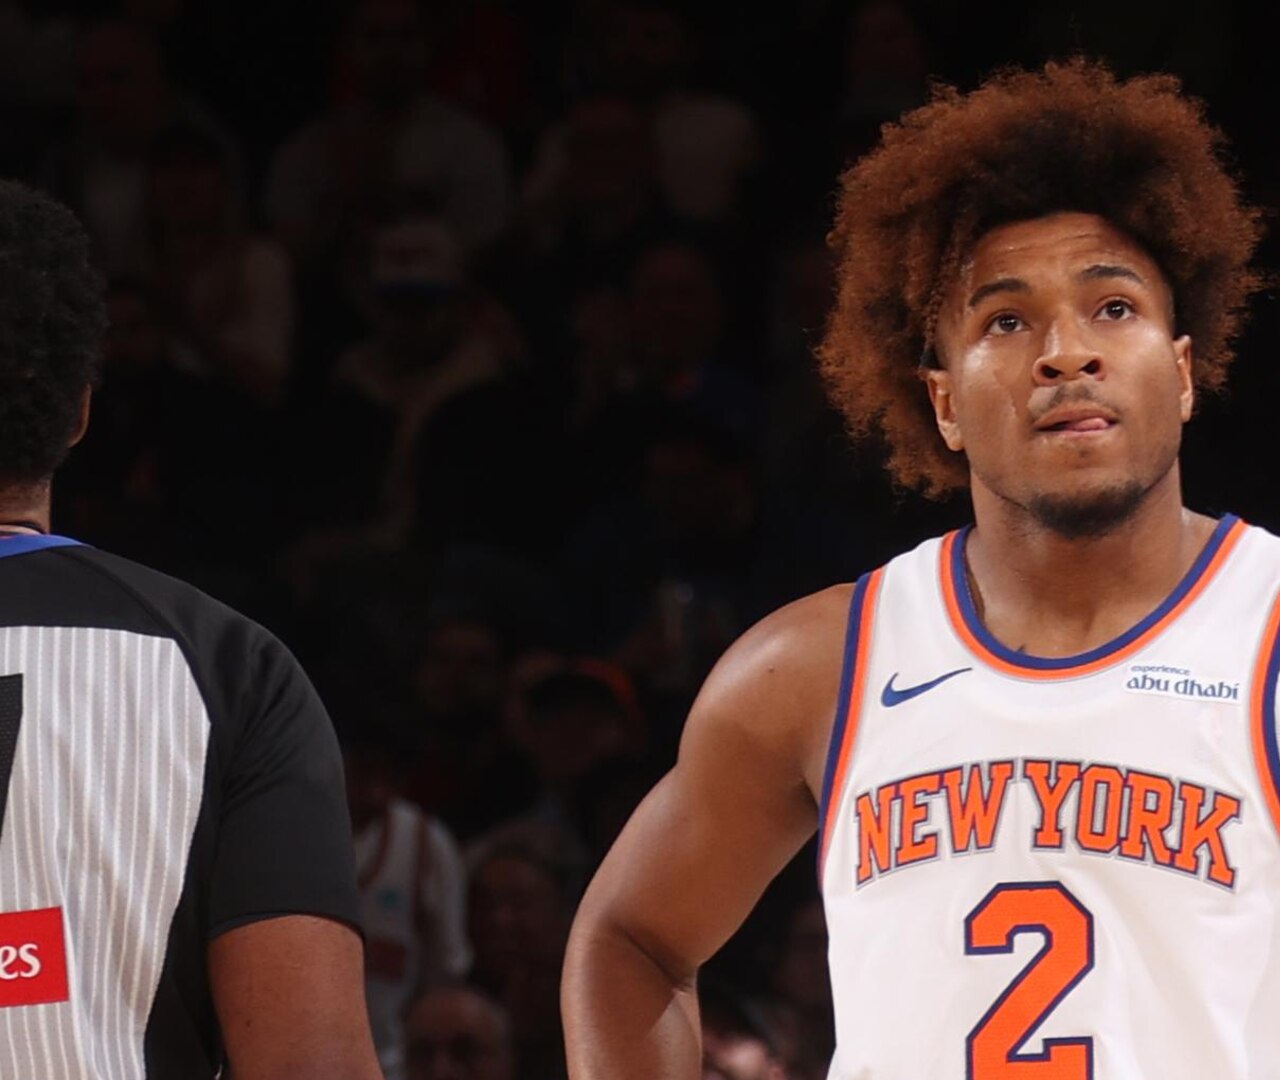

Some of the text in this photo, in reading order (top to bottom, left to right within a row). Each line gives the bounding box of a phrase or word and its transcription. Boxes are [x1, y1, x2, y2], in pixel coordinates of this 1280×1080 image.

[1131, 665, 1191, 676] experience
[1126, 674, 1239, 700] abu dhabi
[855, 757, 1242, 889] NEW YORK
